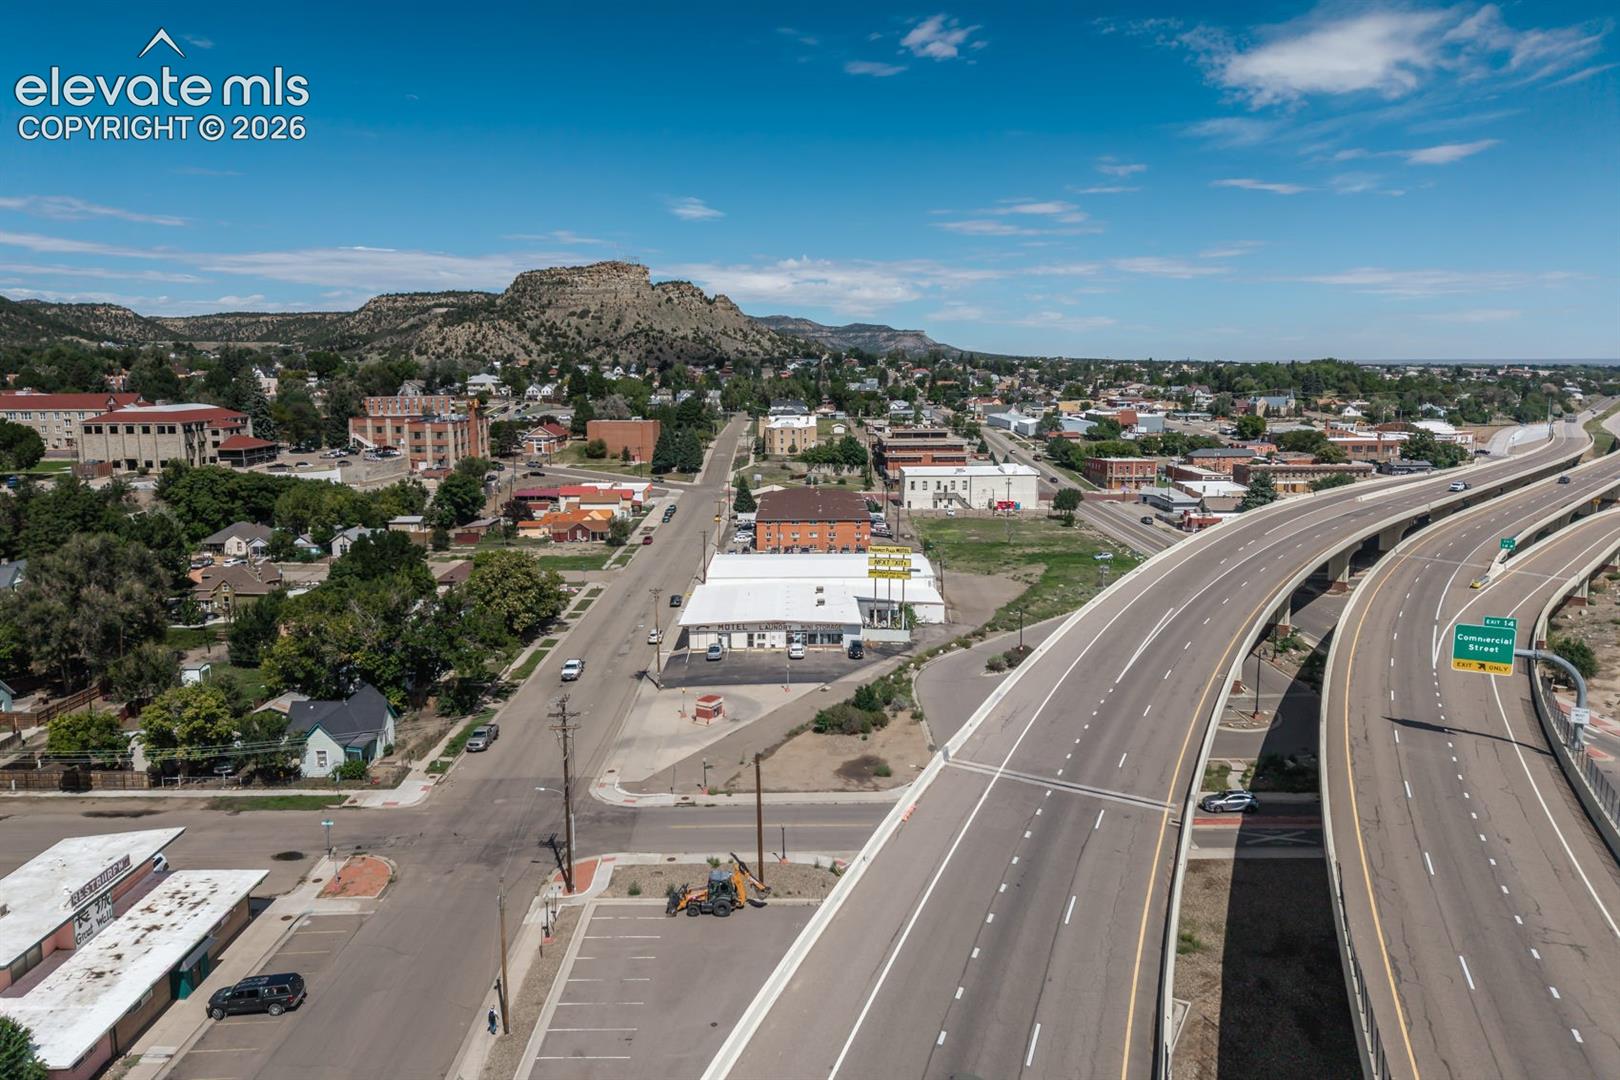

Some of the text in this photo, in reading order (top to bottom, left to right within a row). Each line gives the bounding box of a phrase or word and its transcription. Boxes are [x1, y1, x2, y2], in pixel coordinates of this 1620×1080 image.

[758, 623, 793, 631] LAUNDRY
[1457, 633, 1513, 646] Commercial
[1468, 643, 1499, 653] Street
[96, 908, 113, 927] Wall
